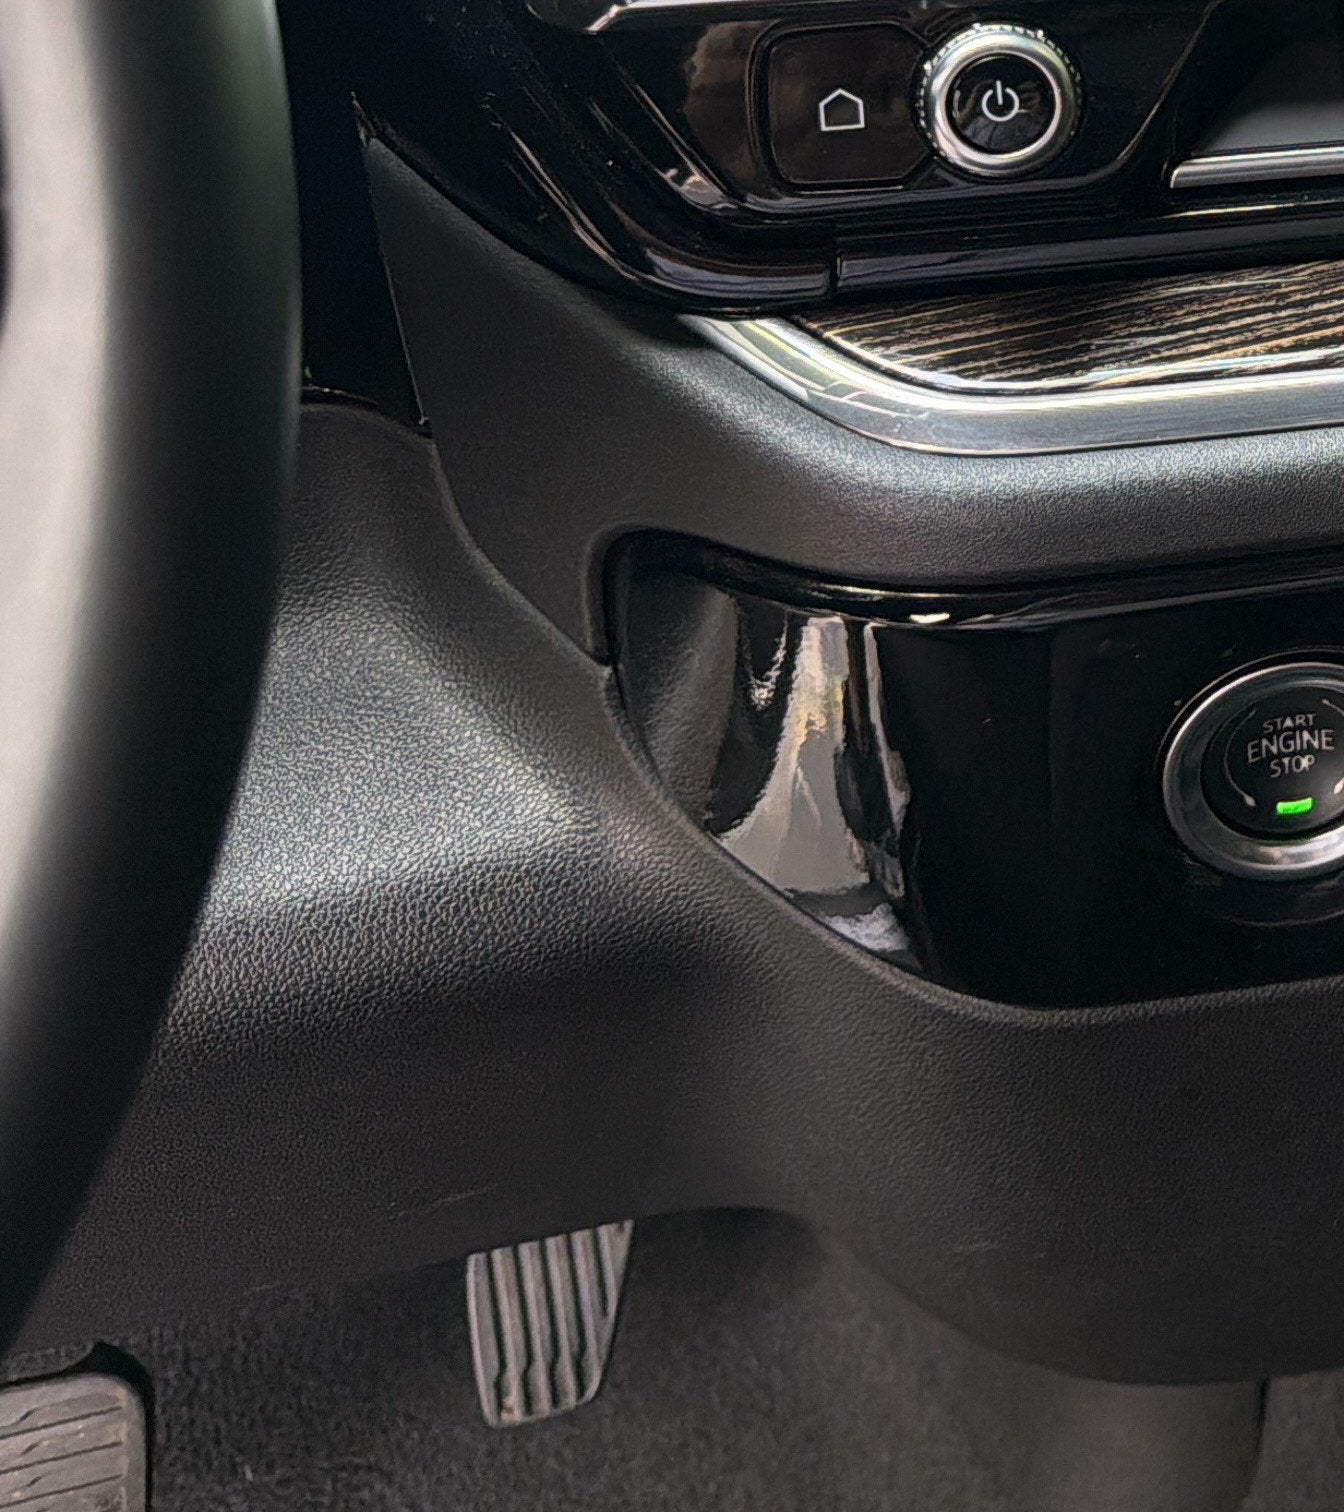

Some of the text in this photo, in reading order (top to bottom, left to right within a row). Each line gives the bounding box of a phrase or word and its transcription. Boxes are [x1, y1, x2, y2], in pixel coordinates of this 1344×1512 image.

[1262, 713, 1317, 734] START
[1247, 729, 1335, 763] ENGINE
[1270, 754, 1316, 778] STOP
